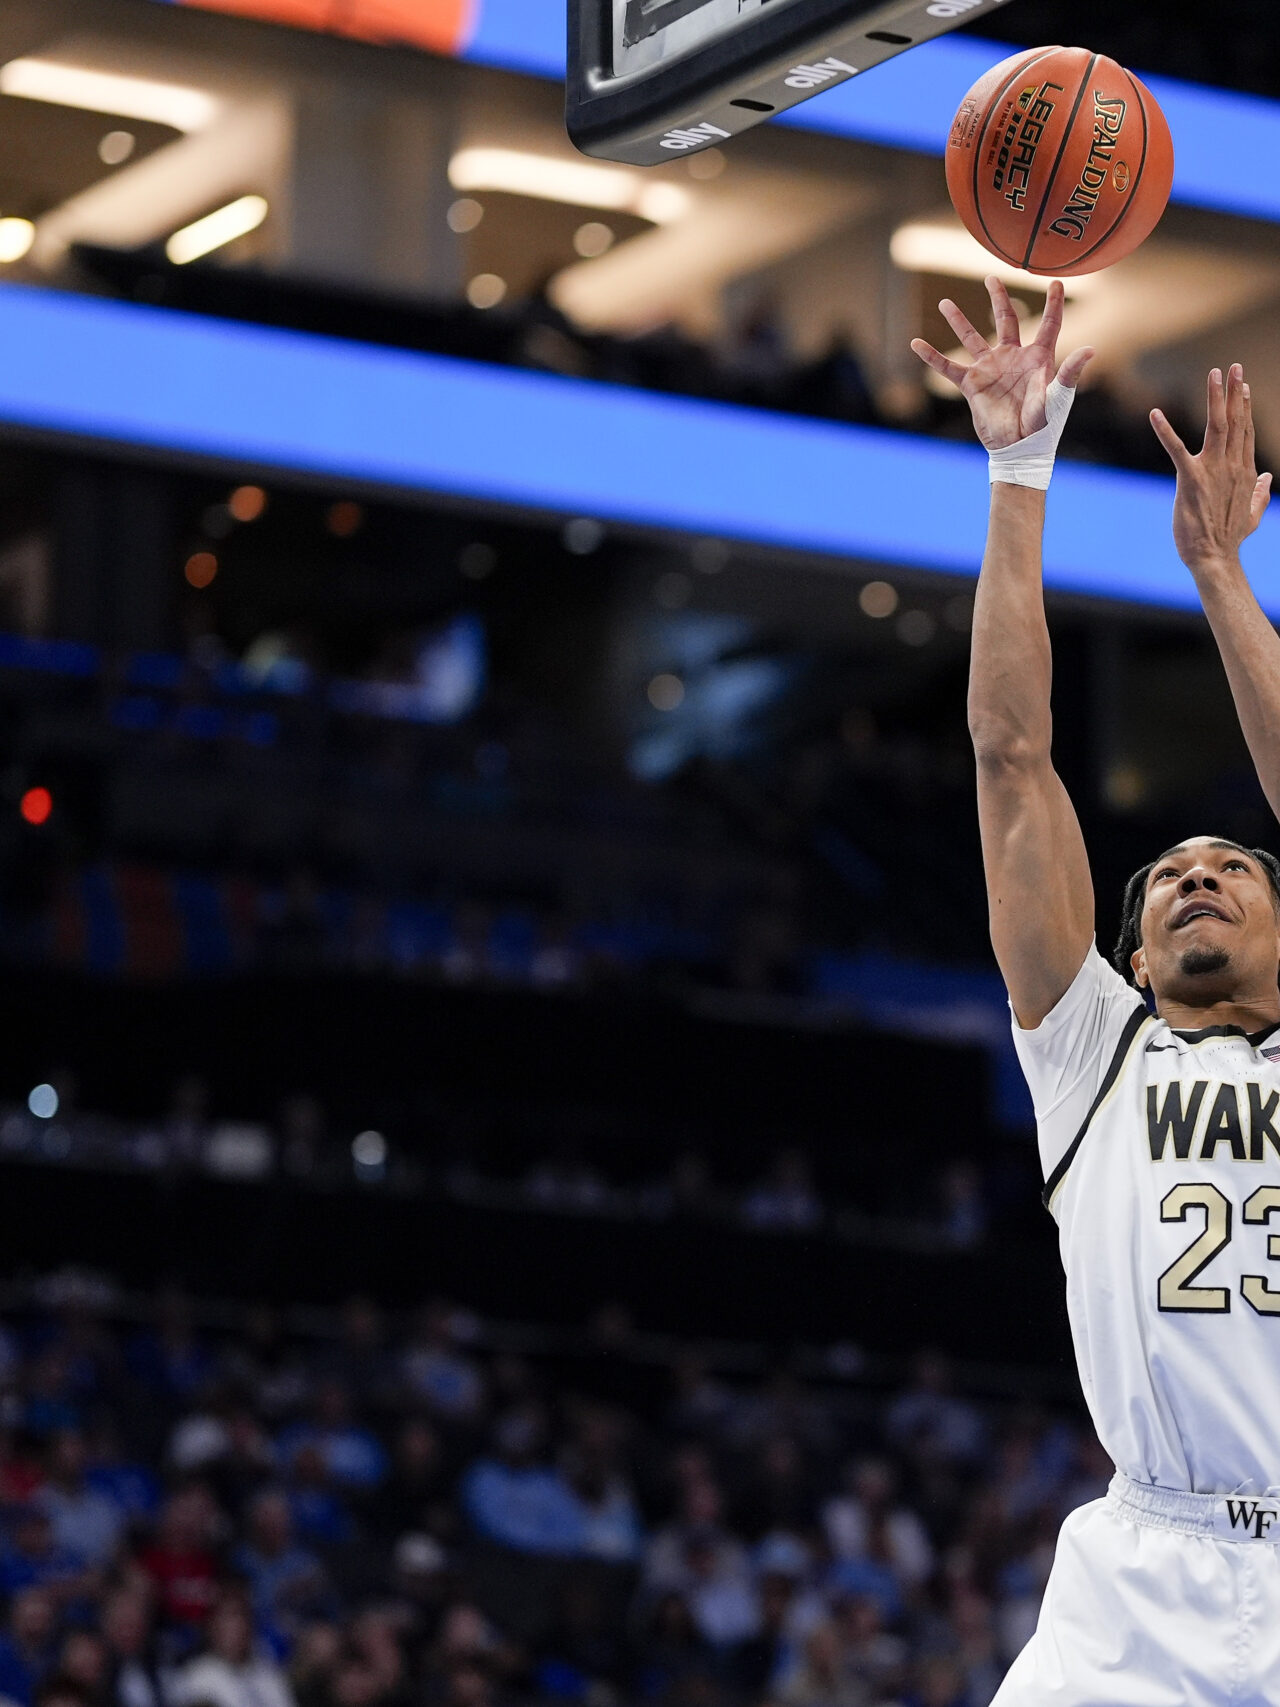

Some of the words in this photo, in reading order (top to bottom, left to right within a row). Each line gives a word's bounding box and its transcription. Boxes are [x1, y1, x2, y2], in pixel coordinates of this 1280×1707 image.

[783, 57, 858, 88] ally
[660, 122, 731, 149] ally
[1004, 81, 1064, 211] LEGACY
[1049, 90, 1127, 241] SPALDING
[1225, 1499, 1278, 1539] WF
